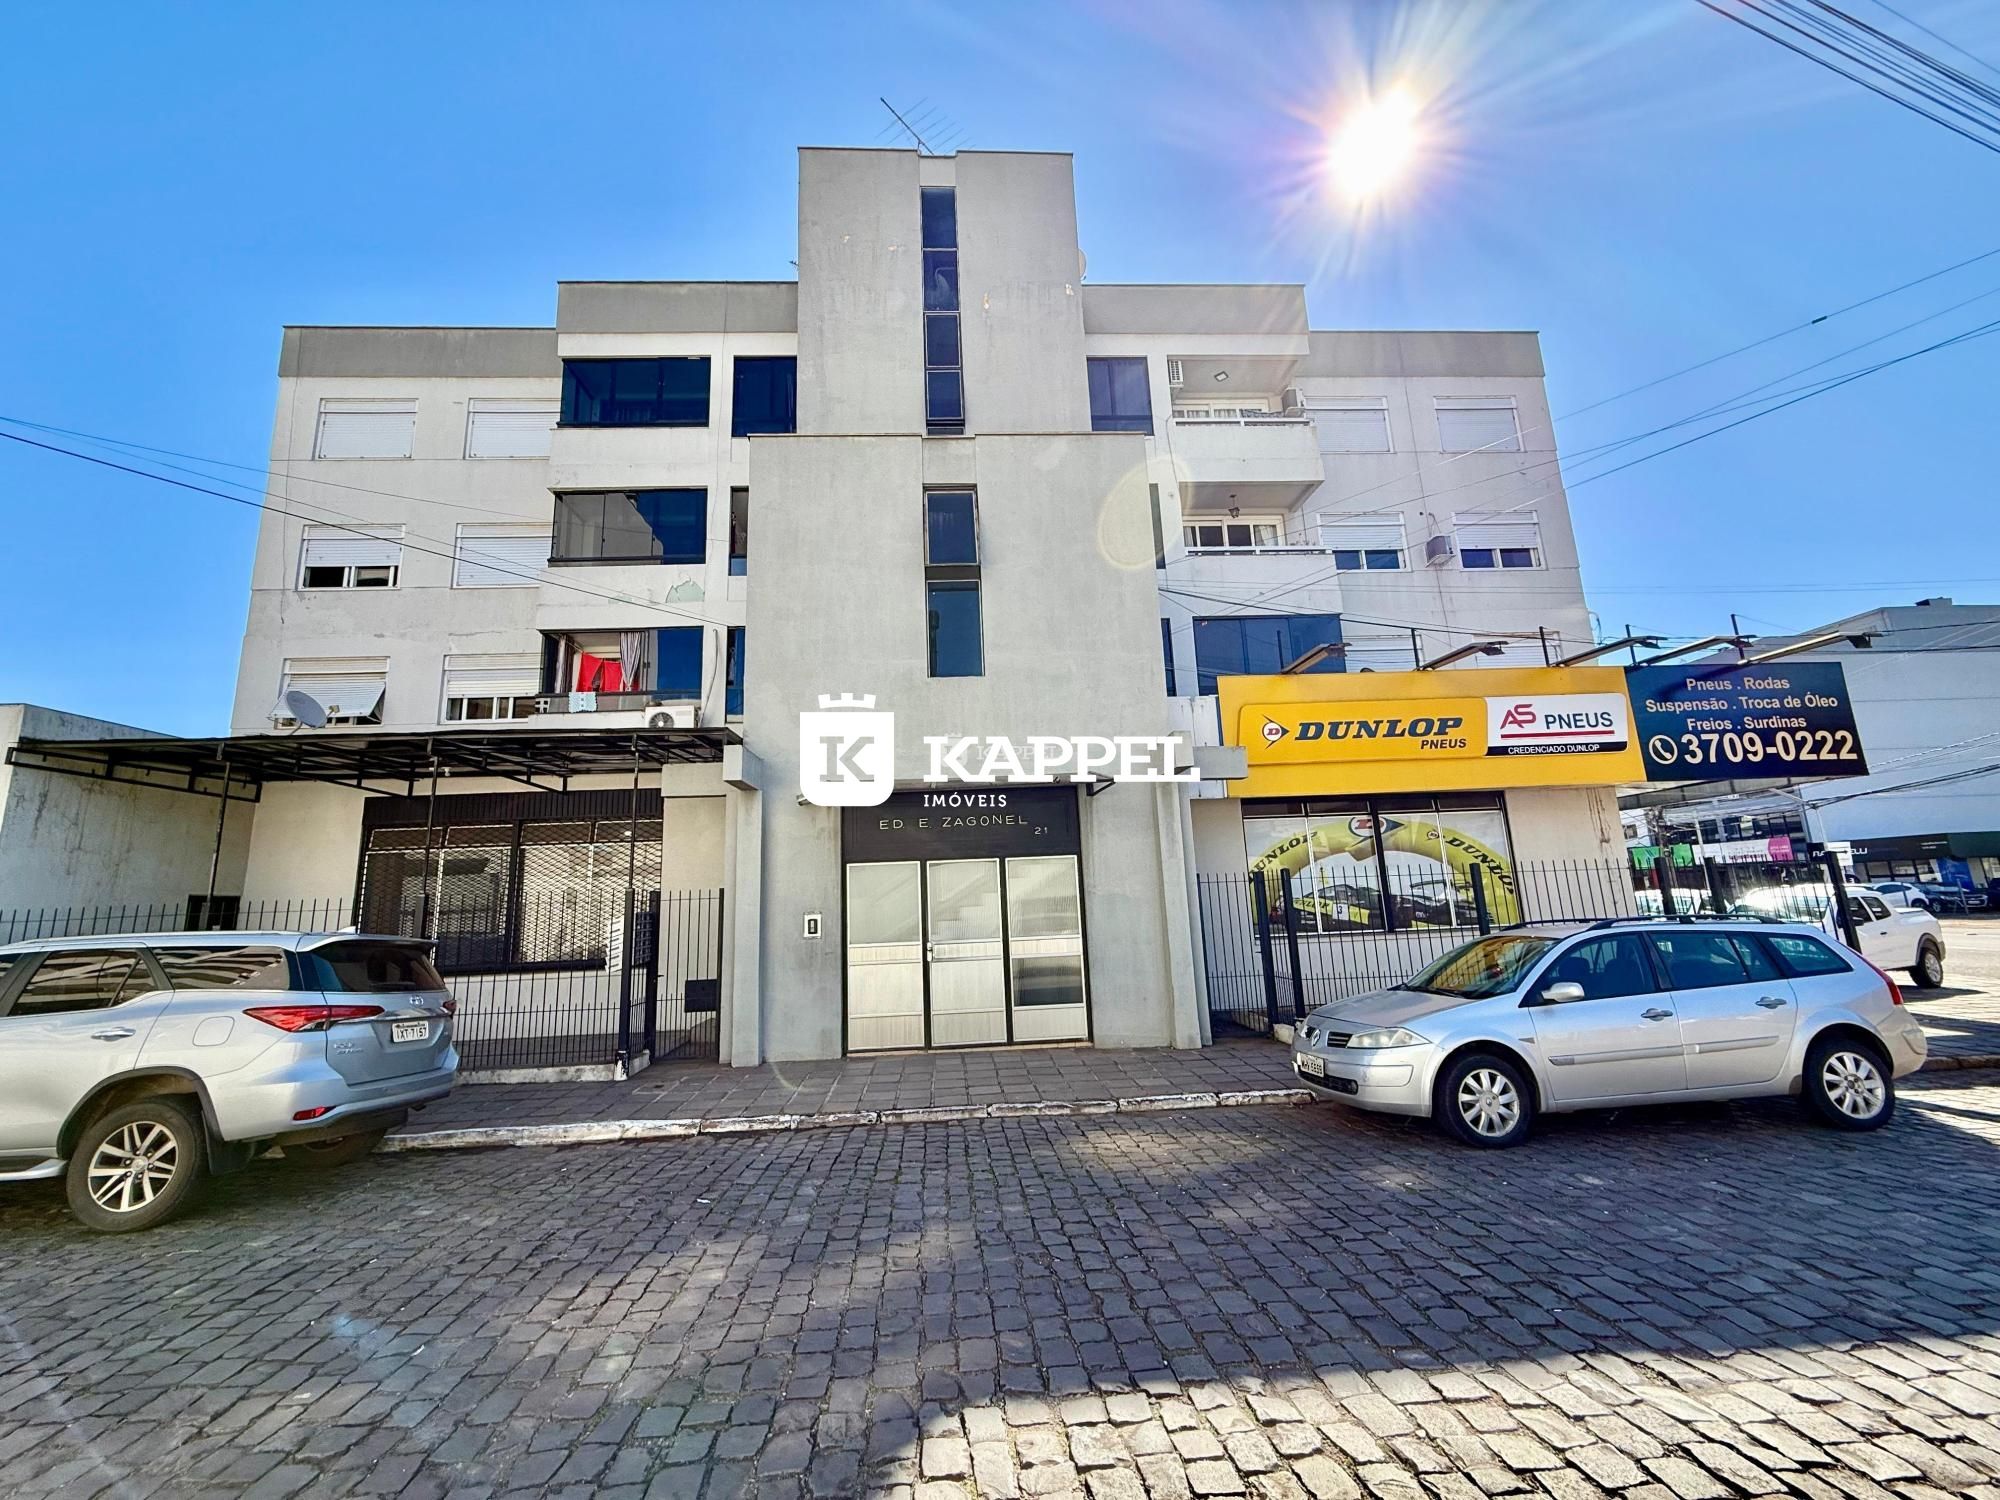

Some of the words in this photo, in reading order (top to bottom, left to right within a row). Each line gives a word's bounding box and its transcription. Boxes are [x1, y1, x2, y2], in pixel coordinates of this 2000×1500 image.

[1686, 678, 1732, 691] Pneus
[1743, 677, 1790, 690] Rodas
[1646, 697, 1728, 714] Suspensão
[1738, 696, 1781, 709] Troca
[1783, 695, 1800, 708] de
[1804, 692, 1838, 708] Óleo
[1500, 704, 1537, 730] AS
[1544, 711, 1614, 730] PNEUS
[1687, 718, 1732, 731] Freios
[1744, 716, 1807, 729] Surdinas
[1294, 717, 1463, 741] DUNLOP
[1420, 738, 1467, 750] PNEUS
[1508, 745, 1566, 755] CREDENCIADO
[1567, 743, 1600, 753] DUNLOP
[1681, 730, 1858, 764] 3709-0222
[879, 819, 905, 830] ED.
[919, 818, 932, 829] E.
[942, 814, 1028, 828] ZAGONEL
[1034, 826, 1048, 835] 21
